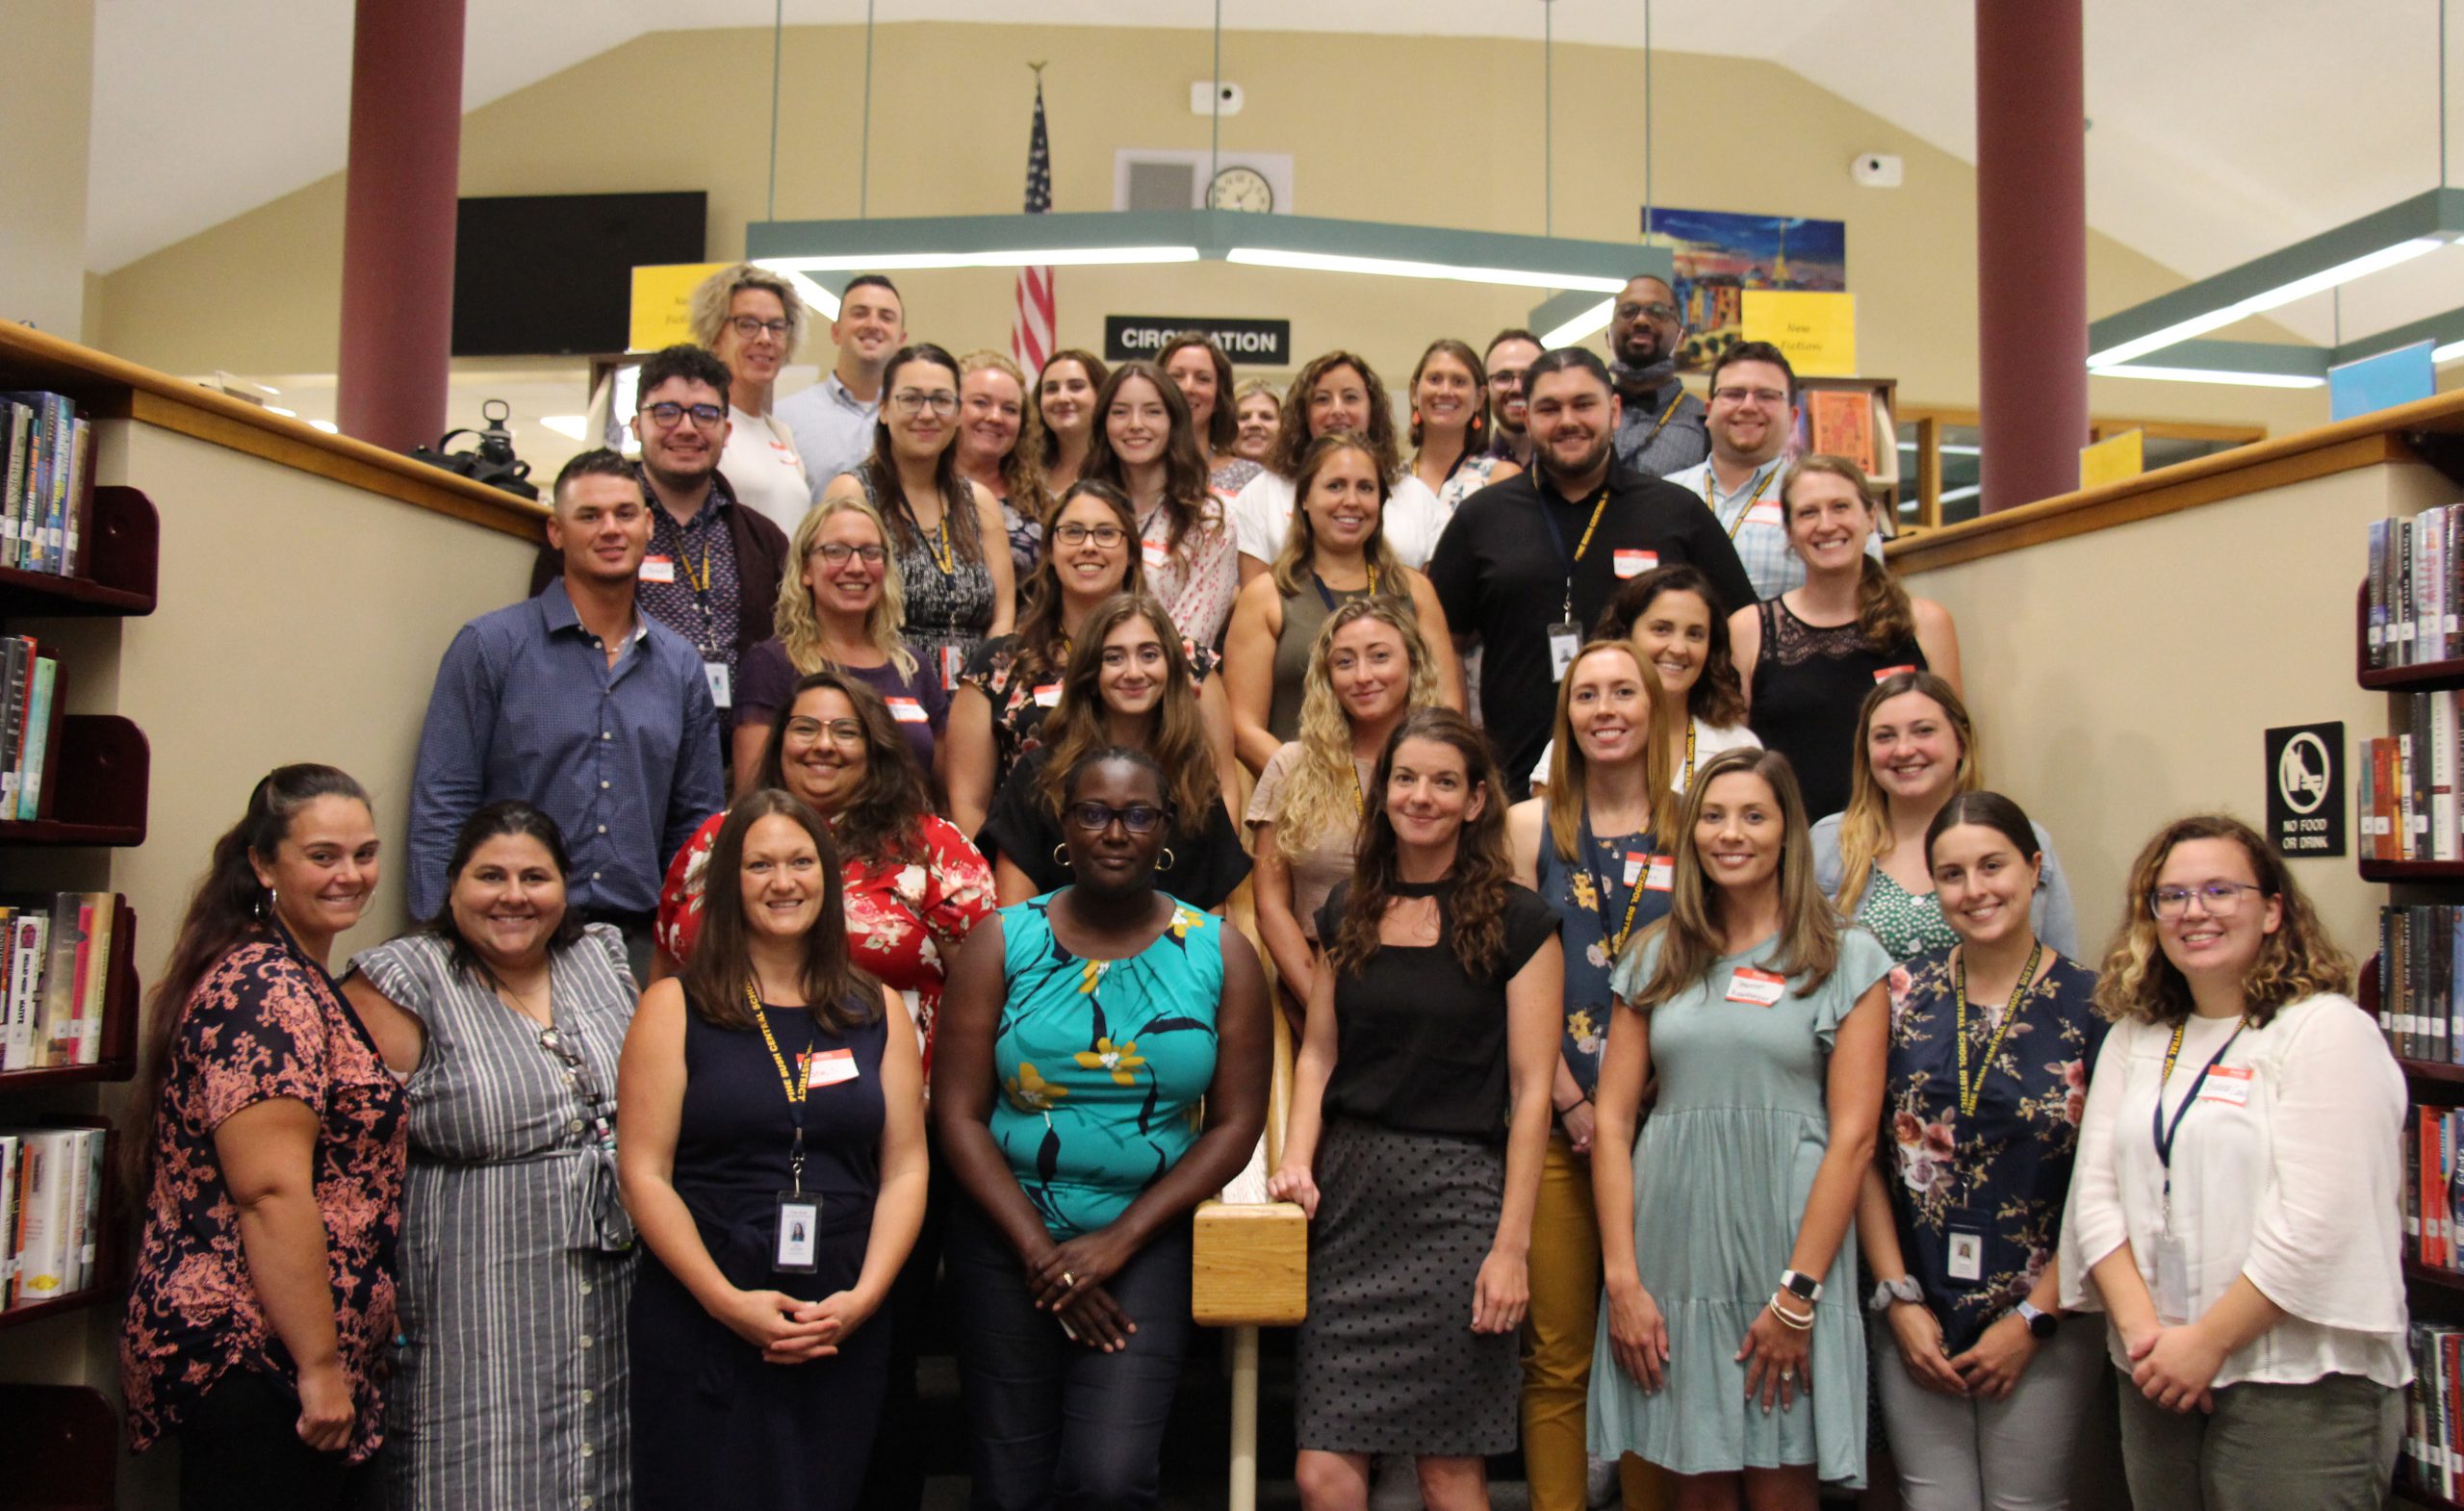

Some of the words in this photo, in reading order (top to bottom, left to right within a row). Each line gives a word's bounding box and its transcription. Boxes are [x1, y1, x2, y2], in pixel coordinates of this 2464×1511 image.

[1121, 328, 1278, 352] CIRCATION
[1786, 323, 1811, 334] New
[1781, 341, 1824, 351] Fiction
[2282, 819, 2297, 832] NO
[2299, 818, 2327, 832] FOOD
[2282, 836, 2297, 850] OR
[2299, 835, 2328, 849] DRINK
[1630, 868, 1649, 904] SCHOOL
[1619, 905, 1636, 947] DISTRIC
[1957, 988, 1966, 1029] CENTRAL
[1972, 1064, 1989, 1092] BUSH
[1985, 1023, 2008, 1065] CENTRAL
[2002, 986, 2024, 1023] SCHOOL
[2019, 946, 2040, 986] DISTRICT
[756, 1011, 779, 1053] CENTRAL
[1958, 1030, 1968, 1068] SCHOOL
[772, 1052, 790, 1079] BUSH
[797, 1057, 810, 1103] DISTRICT
[783, 1079, 798, 1104] PINE
